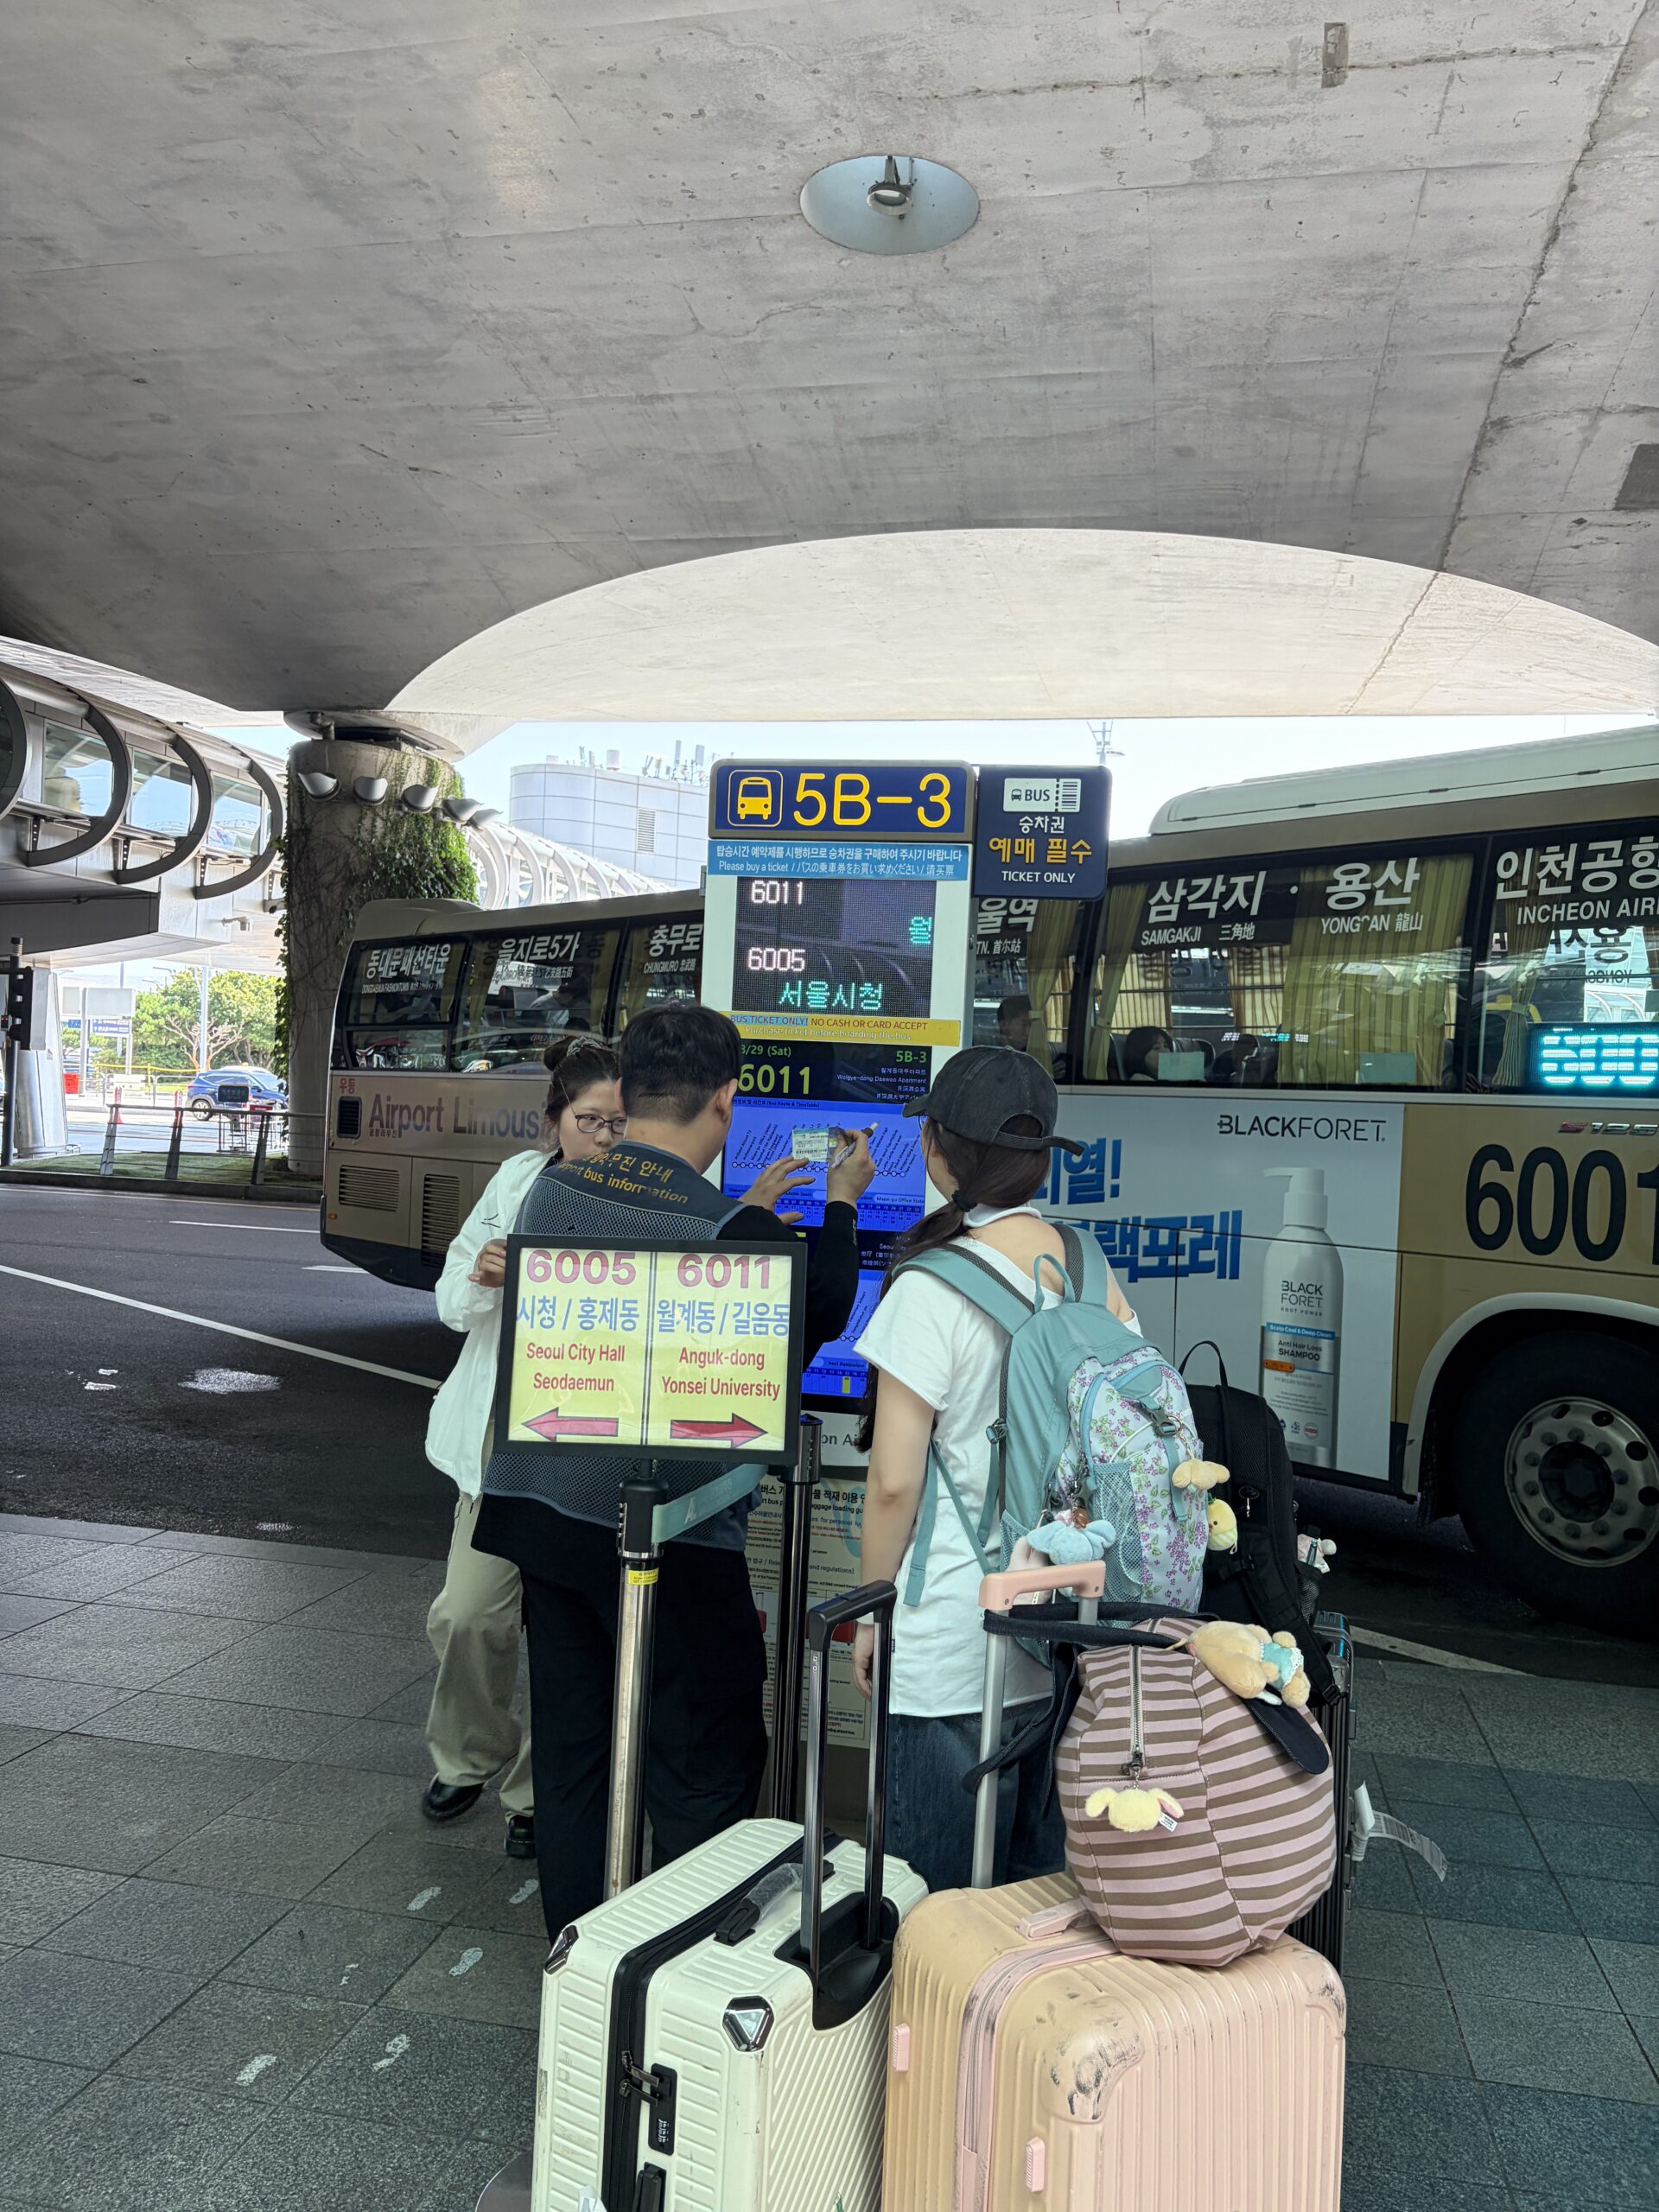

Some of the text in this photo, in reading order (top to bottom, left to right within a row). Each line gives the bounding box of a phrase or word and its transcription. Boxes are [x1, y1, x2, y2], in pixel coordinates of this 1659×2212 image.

[793, 772, 951, 828] 5B-3
[1025, 789, 1050, 802] BUS
[1019, 815, 1065, 834] 승차권
[716, 845, 962, 862] 탑승시간 예약제를 시행하므로 승차권을 구매하여 주시기 바랍니다
[988, 837, 1092, 864] 예매 필수
[719, 861, 744, 871] Please
[747, 862, 760, 873] buy
[768, 862, 788, 872] ticket
[1001, 870, 1076, 883] TICKET ONLY
[1497, 836, 1659, 899] 인천공항
[751, 881, 804, 905] 6011
[1148, 871, 1267, 924] 삼각지
[1325, 857, 1421, 910] 용산
[977, 899, 1039, 934] 울역
[1517, 897, 1659, 925] INCHEON AIR
[1218, 922, 1255, 941] 三角地
[1395, 912, 1424, 932] 龍山
[648, 924, 703, 957] 충무로
[976, 938, 1021, 954] TN. 首尔站
[1141, 926, 1202, 946] SAMGAKJI
[499, 931, 581, 963] 을지로5가
[366, 943, 451, 979] 동대문패션타운
[644, 961, 679, 974] CHUNGMURO
[747, 948, 805, 972] 6005
[779, 981, 882, 1010] 서울시청
[730, 1014, 928, 1031] BUS TICKET ONLY! NO CASH OR CARD ACCEPT
[767, 1046, 791, 1058] (Sat)
[895, 1051, 927, 1063] 5B-3
[339, 1078, 355, 1094] 우등
[738, 1064, 810, 1095] 6011
[368, 1093, 444, 1139] Airport
[1217, 1115, 1387, 1142] BLACKFORET
[584, 1167, 604, 1183] bus
[639, 1160, 674, 1183] 안내
[1465, 1144, 1659, 1265] 6001
[1055, 1210, 1243, 1283] 랙포레
[526, 1249, 637, 1285] 6005
[677, 1254, 771, 1289] 6011
[1281, 1280, 1323, 1296] BLACK
[1281, 1293, 1323, 1308] FORET
[526, 1343, 626, 1364] Seoul City Hall
[1279, 1348, 1320, 1362] SHAMPOO
[1306, 1344, 1322, 1352] Loss
[679, 1347, 765, 1370] Anguk-dong
[533, 1372, 614, 1392] Seodaemun
[662, 1376, 780, 1402] Yonsei University
[761, 1484, 777, 1495] 버스
[823, 1490, 840, 1502] 적재
[842, 1492, 858, 1503] 이용
[832, 1505, 855, 1514] loading
